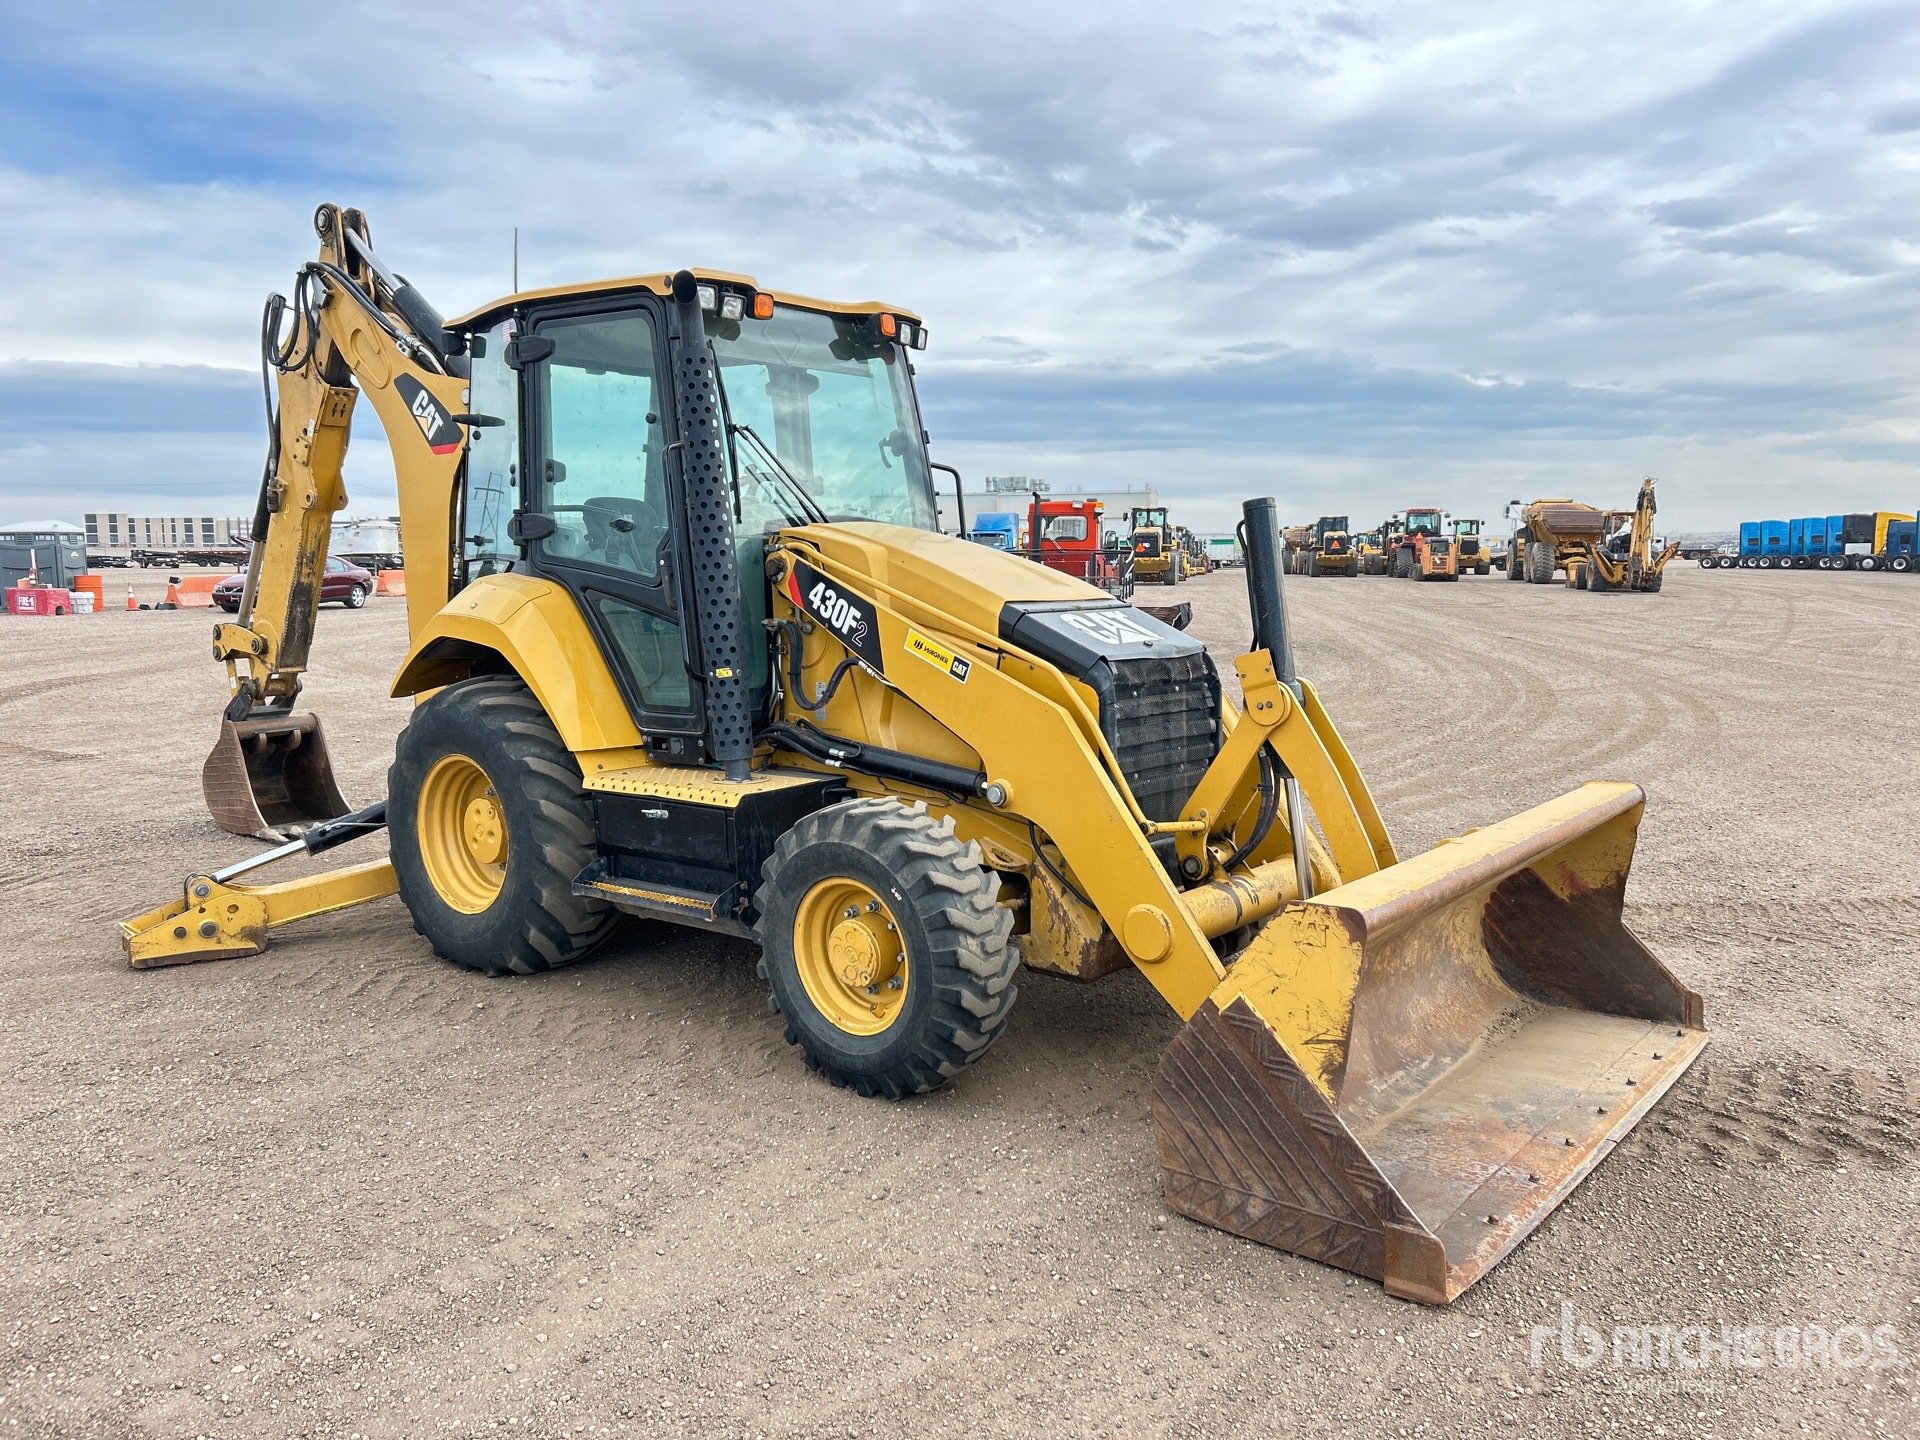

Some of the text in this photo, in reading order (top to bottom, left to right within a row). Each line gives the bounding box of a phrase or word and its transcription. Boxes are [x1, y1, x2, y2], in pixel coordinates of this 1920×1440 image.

[412, 389, 444, 441] CAT
[808, 581, 868, 648] 430F2
[1059, 610, 1166, 645] CAT
[923, 645, 968, 676] WAGNER CAT
